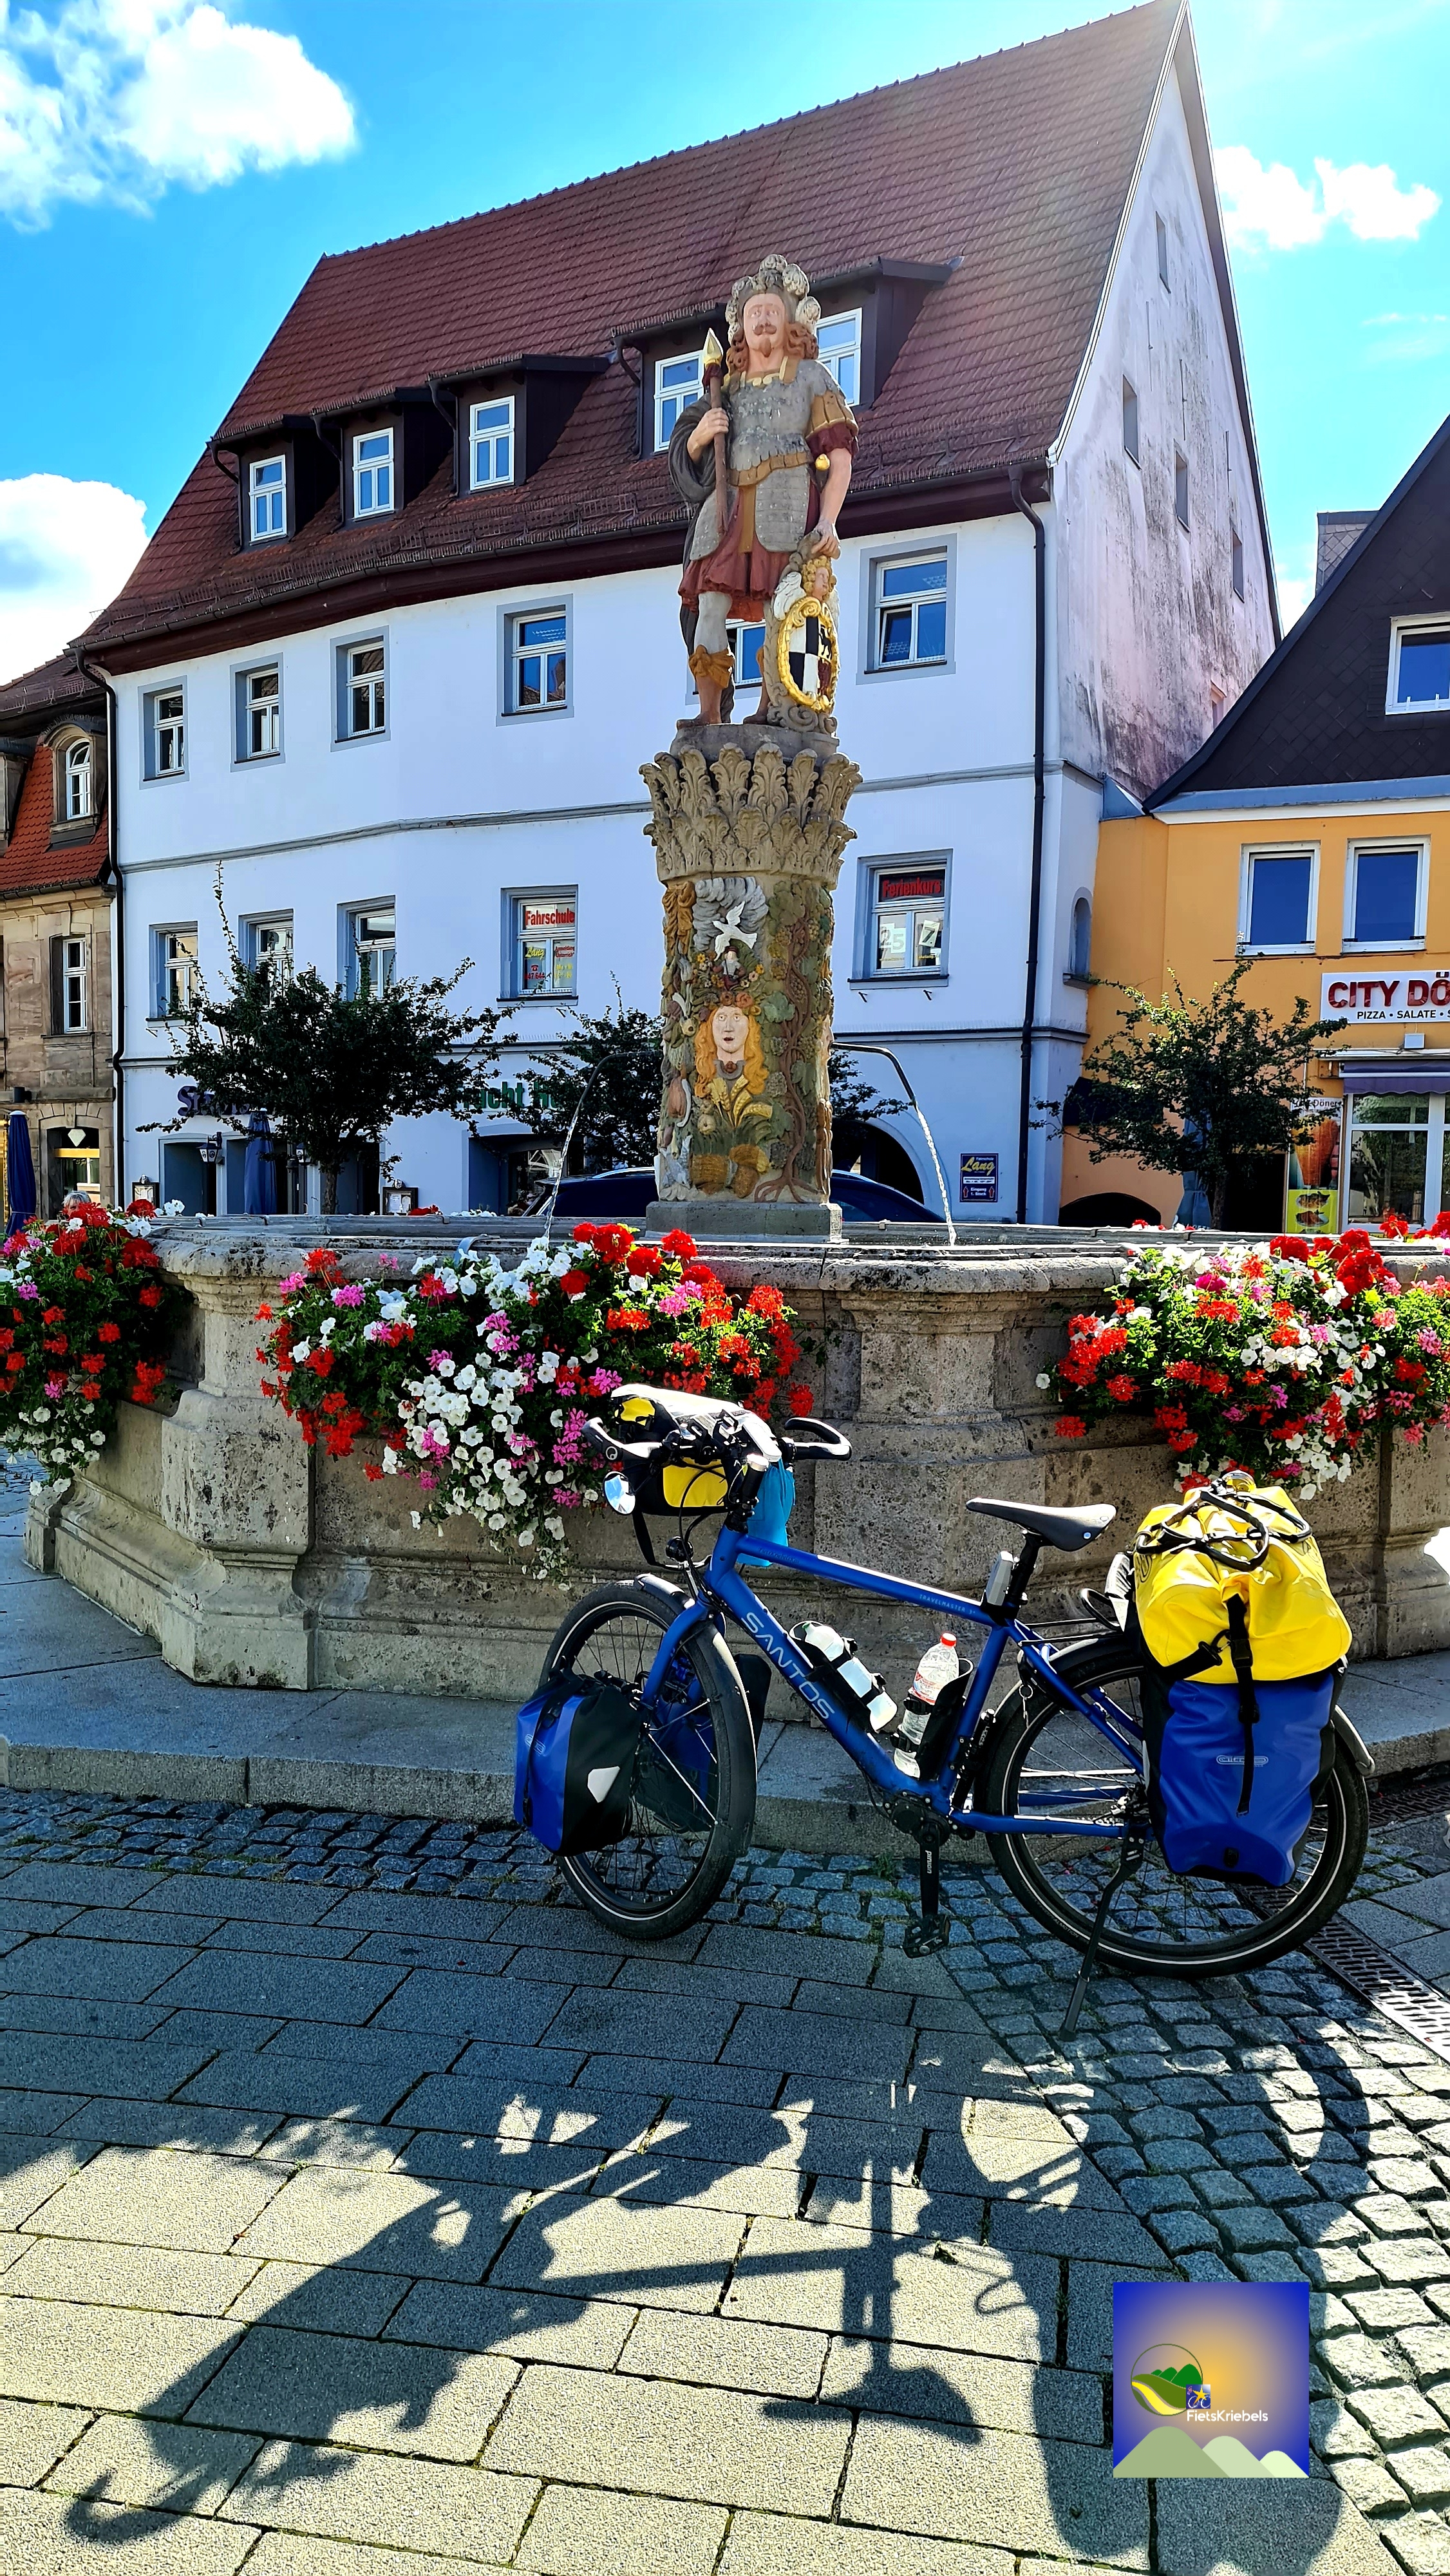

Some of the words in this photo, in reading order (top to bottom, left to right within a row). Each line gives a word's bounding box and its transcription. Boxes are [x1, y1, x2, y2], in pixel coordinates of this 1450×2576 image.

[882, 877, 941, 898] Ferienkurs
[525, 907, 575, 926] Fahrschule
[525, 947, 545, 960] Lang
[1328, 980, 1400, 1009] CITY
[1408, 971, 1450, 1007] DÖ
[1357, 1011, 1386, 1019] PIZZA
[1397, 1010, 1436, 1019] SALATE
[1313, 1099, 1338, 1108] Döner
[961, 1156, 996, 1177] Lang
[919, 1594, 966, 1613] TRAVELMASTER
[741, 1612, 836, 1719] SANTOS
